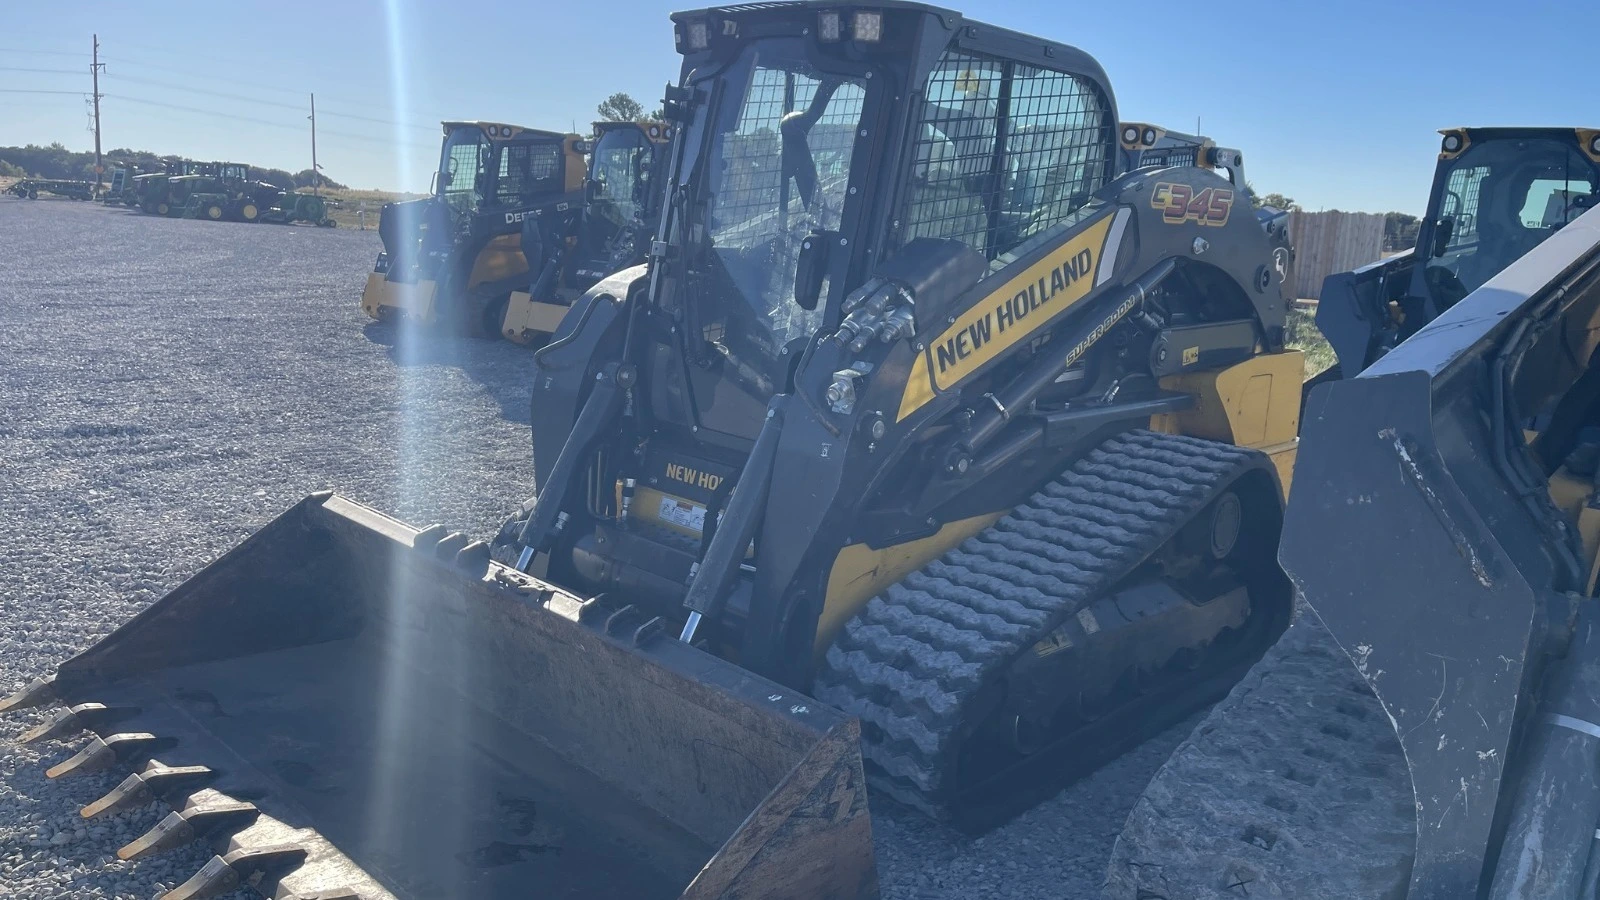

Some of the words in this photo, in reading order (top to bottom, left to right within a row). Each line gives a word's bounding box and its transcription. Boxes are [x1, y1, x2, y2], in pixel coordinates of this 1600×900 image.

[1151, 182, 1234, 227] C345
[936, 312, 991, 374] NEW
[996, 247, 1092, 334] HOLLAND
[1066, 324, 1104, 367] SUPER
[1104, 295, 1135, 332] BOOM
[666, 462, 697, 485] NEW
